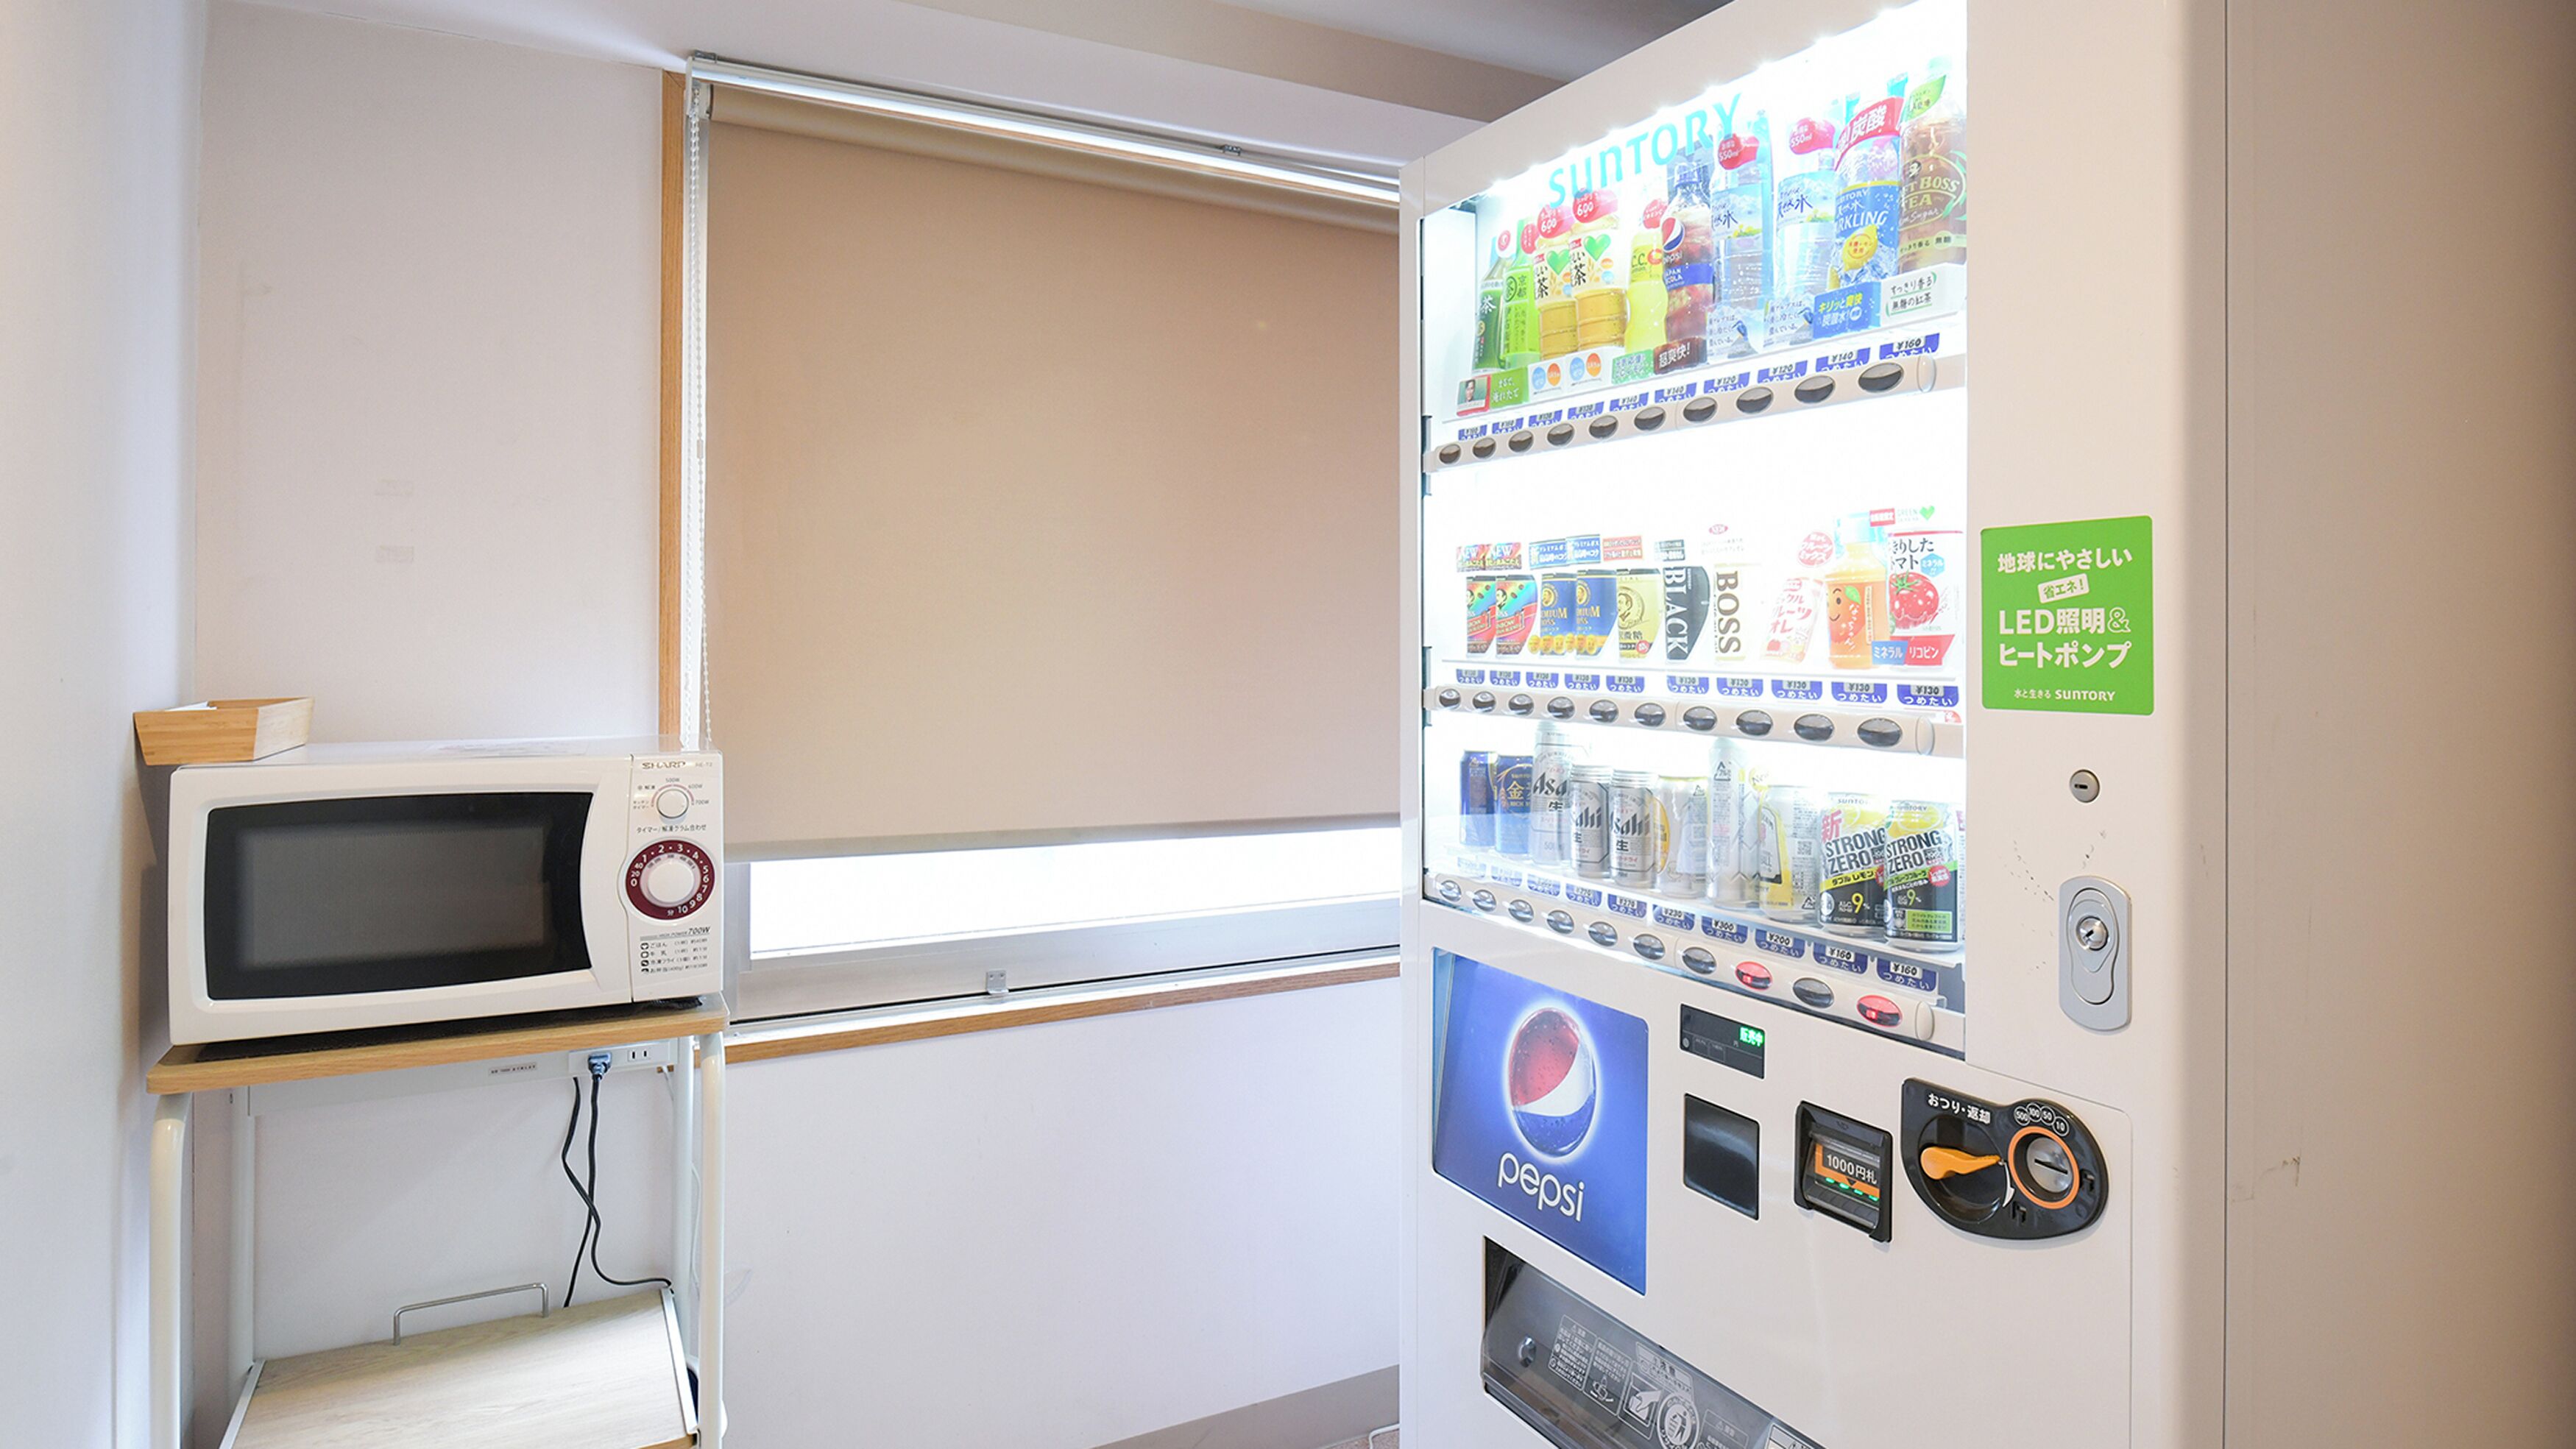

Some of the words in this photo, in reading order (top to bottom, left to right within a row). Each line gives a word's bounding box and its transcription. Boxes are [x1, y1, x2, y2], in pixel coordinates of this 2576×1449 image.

[1548, 93, 1742, 209] SUNTORY
[1919, 177, 1960, 192] BOSS
[1897, 338, 1922, 350] ¥160
[1832, 351, 1854, 363] ¥140
[1772, 364, 1793, 375] ¥120
[1716, 375, 1736, 386] ¥120
[1998, 548, 2133, 573] 地球にやさしい
[2043, 578, 2084, 599] 省エネ!
[1663, 567, 1688, 654] BLACK
[1716, 570, 1742, 654] BOSS
[1999, 607, 2131, 634] LED照明&
[1872, 646, 1903, 659] ミネラル
[1909, 646, 1939, 659] リコピン
[1999, 640, 2132, 669] ヒートポンプ
[1731, 679, 1749, 687] ¥130
[1787, 680, 1807, 689] ¥130
[1848, 682, 1870, 692] ¥130
[1722, 687, 1759, 697] つめたい
[1778, 687, 1818, 699] つめたい
[1916, 685, 1939, 695] ¥130
[2014, 688, 2051, 699] 水と生きる
[2055, 690, 2115, 701] SUNTORY
[1838, 692, 1883, 703] つめたい
[1904, 695, 1953, 706] つめたい
[642, 760, 686, 769] SHARP
[1549, 800, 1564, 812] 生
[1822, 809, 1842, 843] 新
[658, 844, 664, 853] 2
[678, 843, 684, 852] 3
[1616, 840, 1630, 852] 生
[1825, 826, 1886, 860] STRONG
[1886, 829, 1942, 859] STRONG
[1828, 848, 1872, 876] ZERO
[1889, 851, 1924, 875] ZERO
[703, 865, 709, 874] 5
[1853, 869, 1875, 882] レモン
[630, 878, 638, 888] 0
[703, 874, 709, 882] 6
[701, 885, 707, 893] 7
[696, 893, 702, 901] 8
[678, 904, 688, 913] 10
[690, 900, 696, 909] 9
[1664, 907, 1682, 918] ¥230
[1656, 915, 1691, 930] つめたい
[1713, 920, 1734, 932] ¥300
[688, 926, 711, 935] 700W
[1707, 929, 1743, 943] つめたい
[1768, 934, 1791, 946] ¥200
[1760, 940, 1800, 957] つめたい
[1829, 949, 1852, 960] ¥160
[1819, 957, 1862, 973] つめたい
[1893, 963, 1917, 976] ¥160
[1883, 972, 1930, 991] つめたい
[1928, 1093, 1991, 1124] おつり・返却
[2016, 1110, 2028, 1122] 500
[2029, 1107, 2039, 1118] 100
[2043, 1110, 2052, 1121] 50
[2056, 1121, 2065, 1132] 10
[1826, 1153, 1878, 1185] 1000円札
[1497, 1151, 1585, 1222] pepsi
